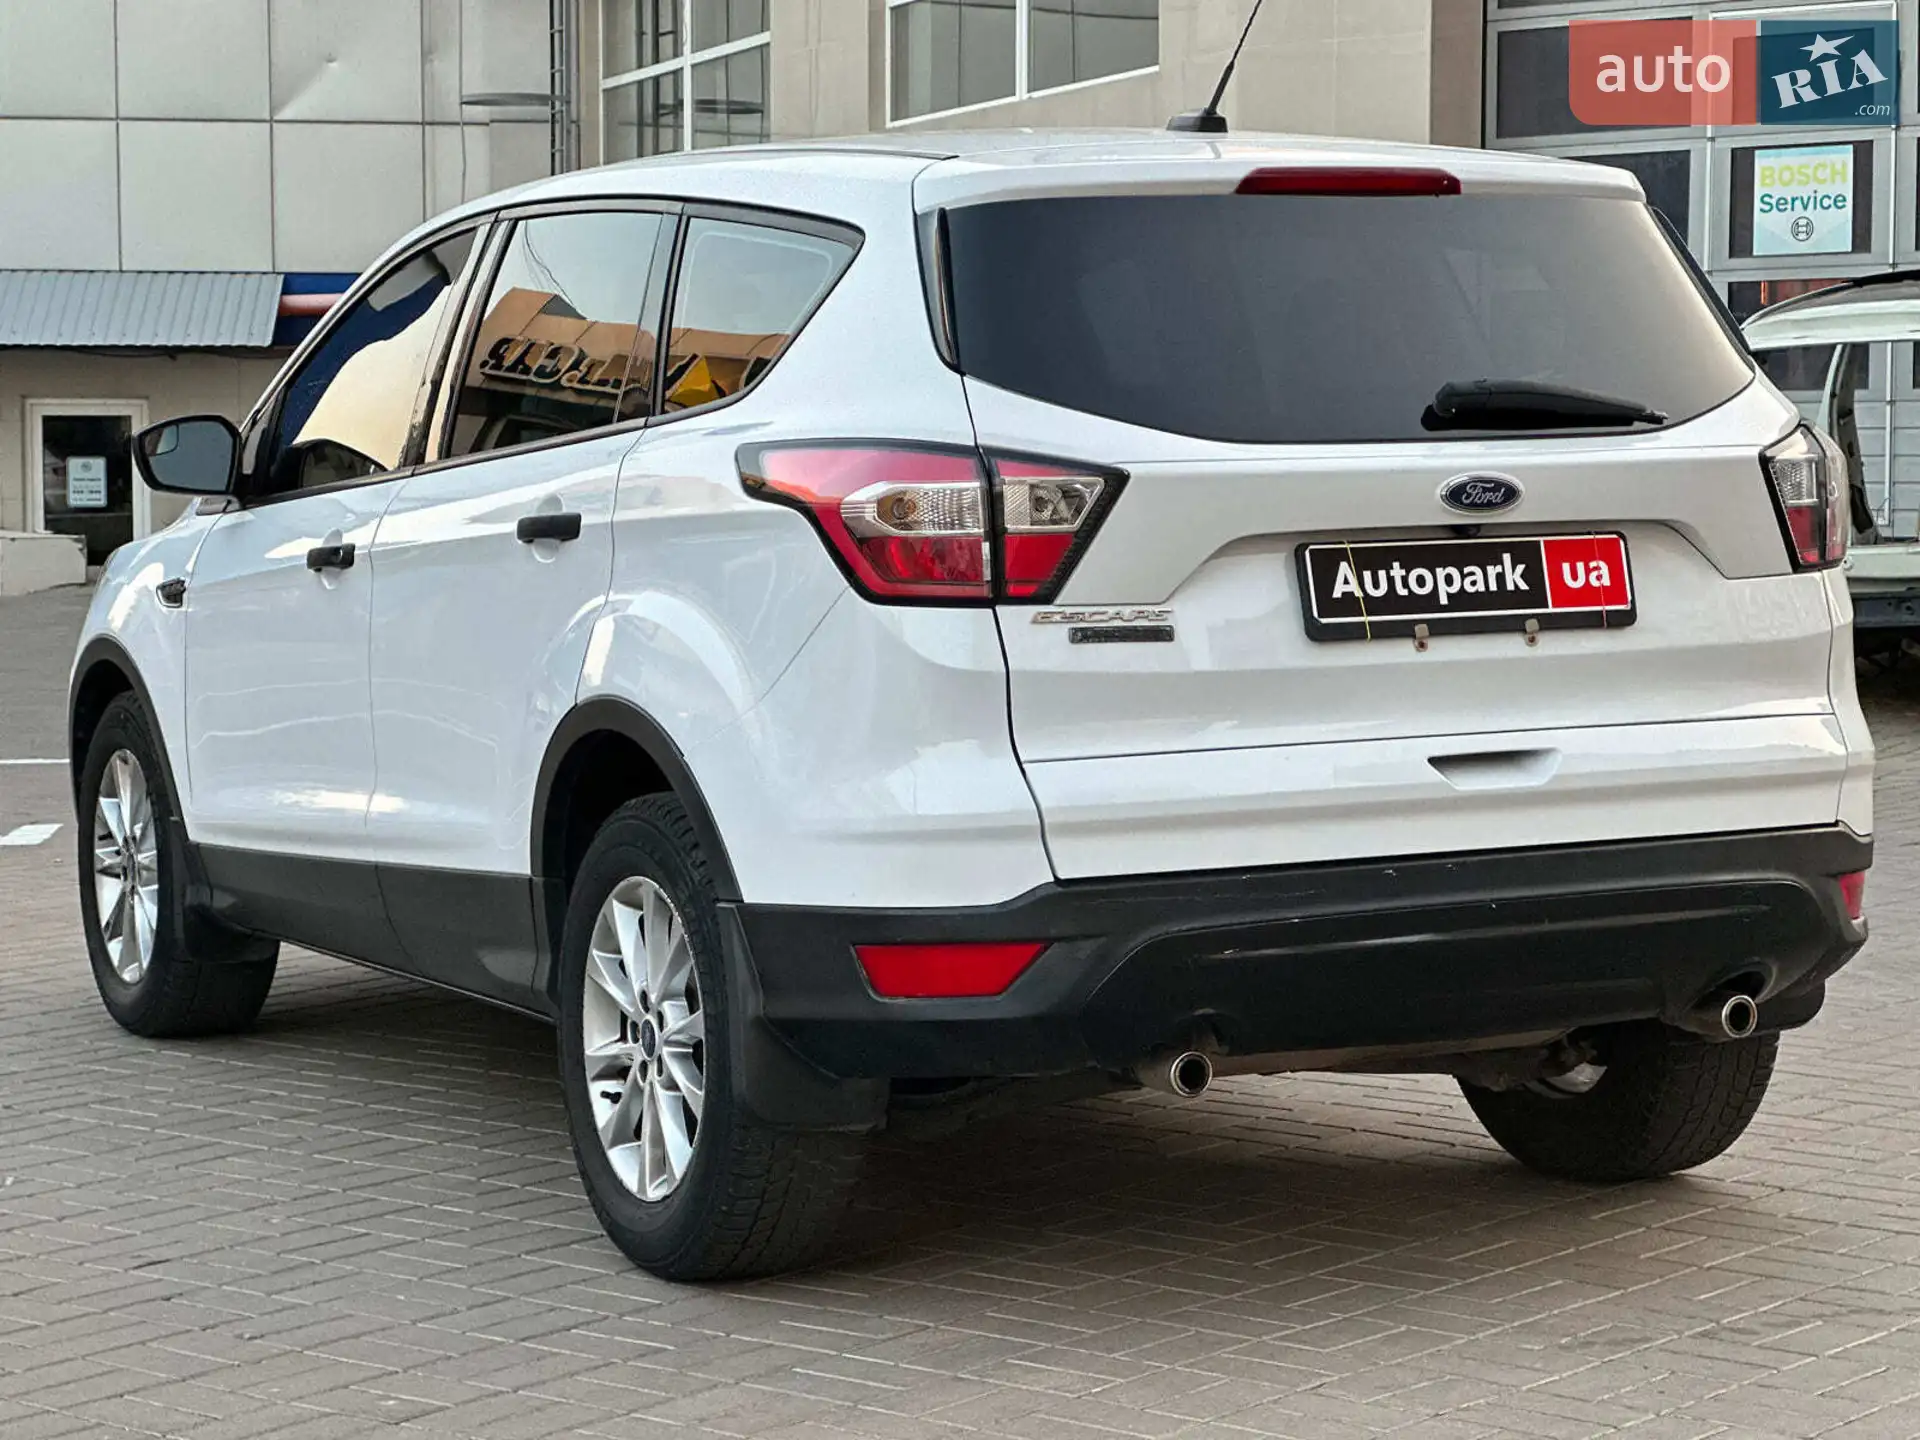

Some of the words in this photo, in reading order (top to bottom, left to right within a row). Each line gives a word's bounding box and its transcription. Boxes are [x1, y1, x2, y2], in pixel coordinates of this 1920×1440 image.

[1760, 161, 1848, 188] BOSCH
[1760, 189, 1847, 213] Service
[1462, 482, 1505, 504] Ford
[1332, 553, 1529, 605] Autopark
[1562, 559, 1612, 588] ua
